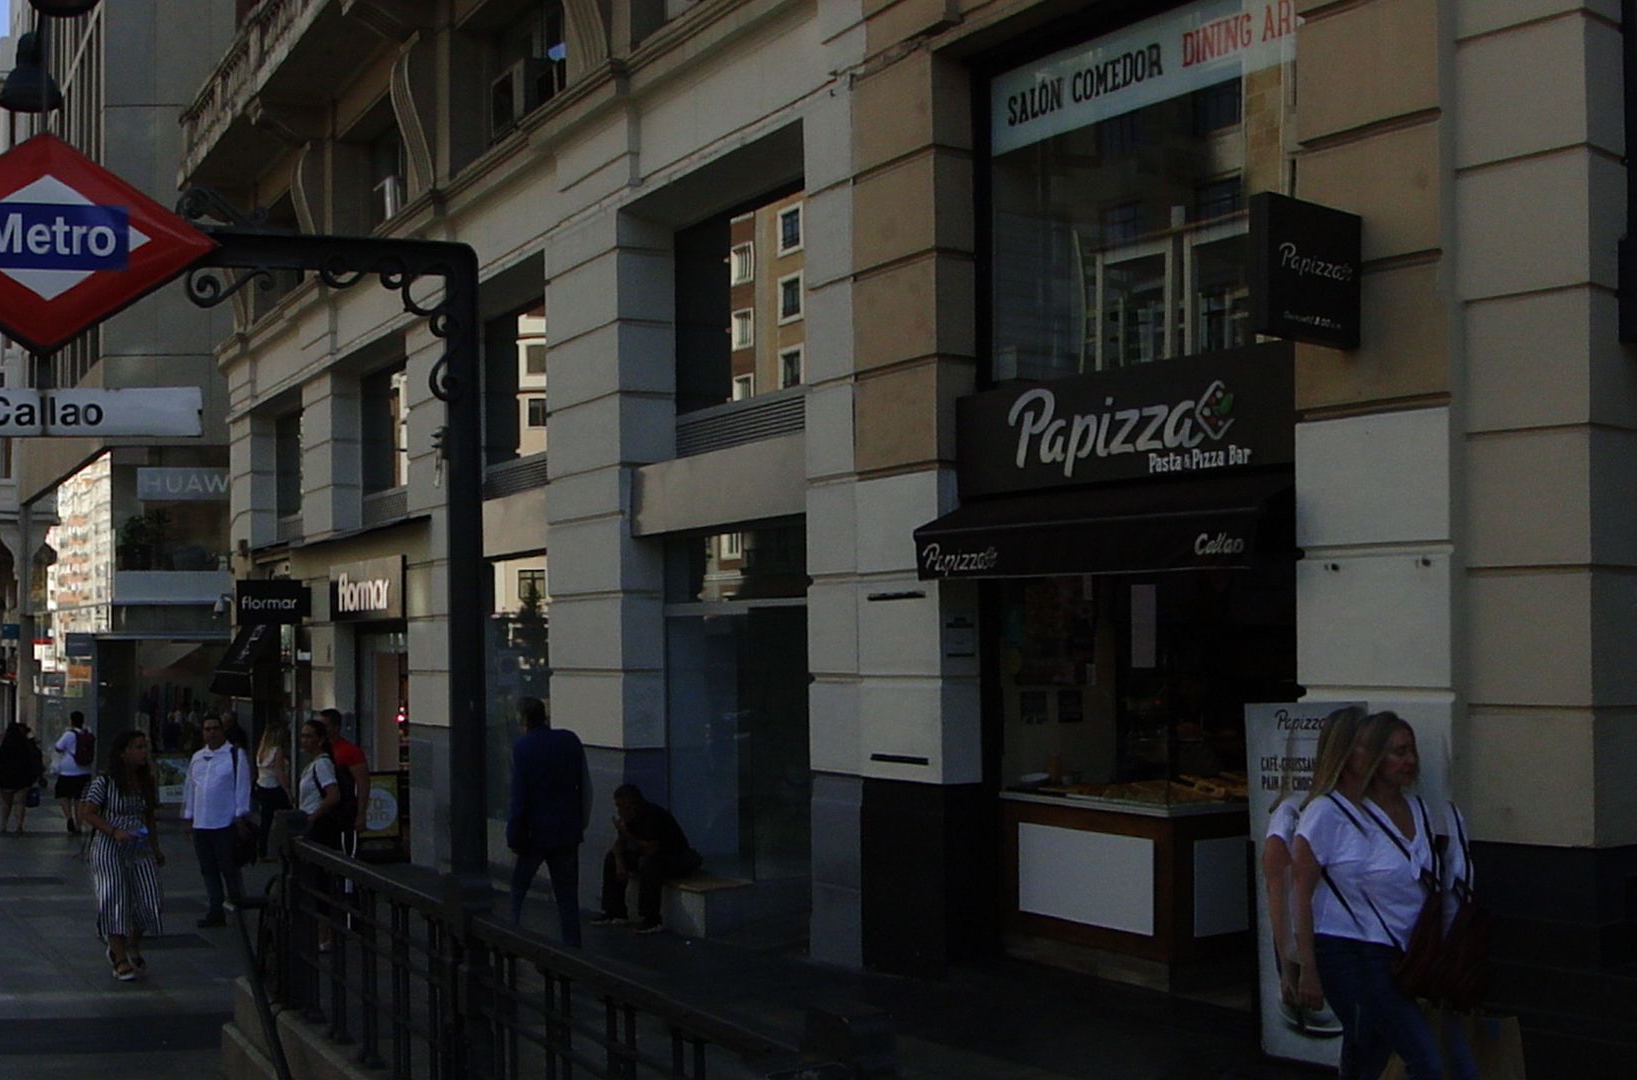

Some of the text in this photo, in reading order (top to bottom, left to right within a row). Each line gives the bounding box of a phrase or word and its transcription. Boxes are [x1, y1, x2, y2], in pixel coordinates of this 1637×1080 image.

[1007, 76, 1064, 127] SALÓN
[1072, 43, 1164, 104] COMEDOR
[1181, 14, 1253, 68] DINING
[1278, 242, 1344, 281] Papizza
[1008, 388, 1205, 478] Papizza
[1149, 452, 1182, 473] Pasta
[1191, 448, 1225, 470] Pizza
[1228, 444, 1253, 465] Bar
[922, 532, 1245, 577] Papizza Callao
[241, 595, 298, 612] flormar
[337, 572, 390, 613] flormar
